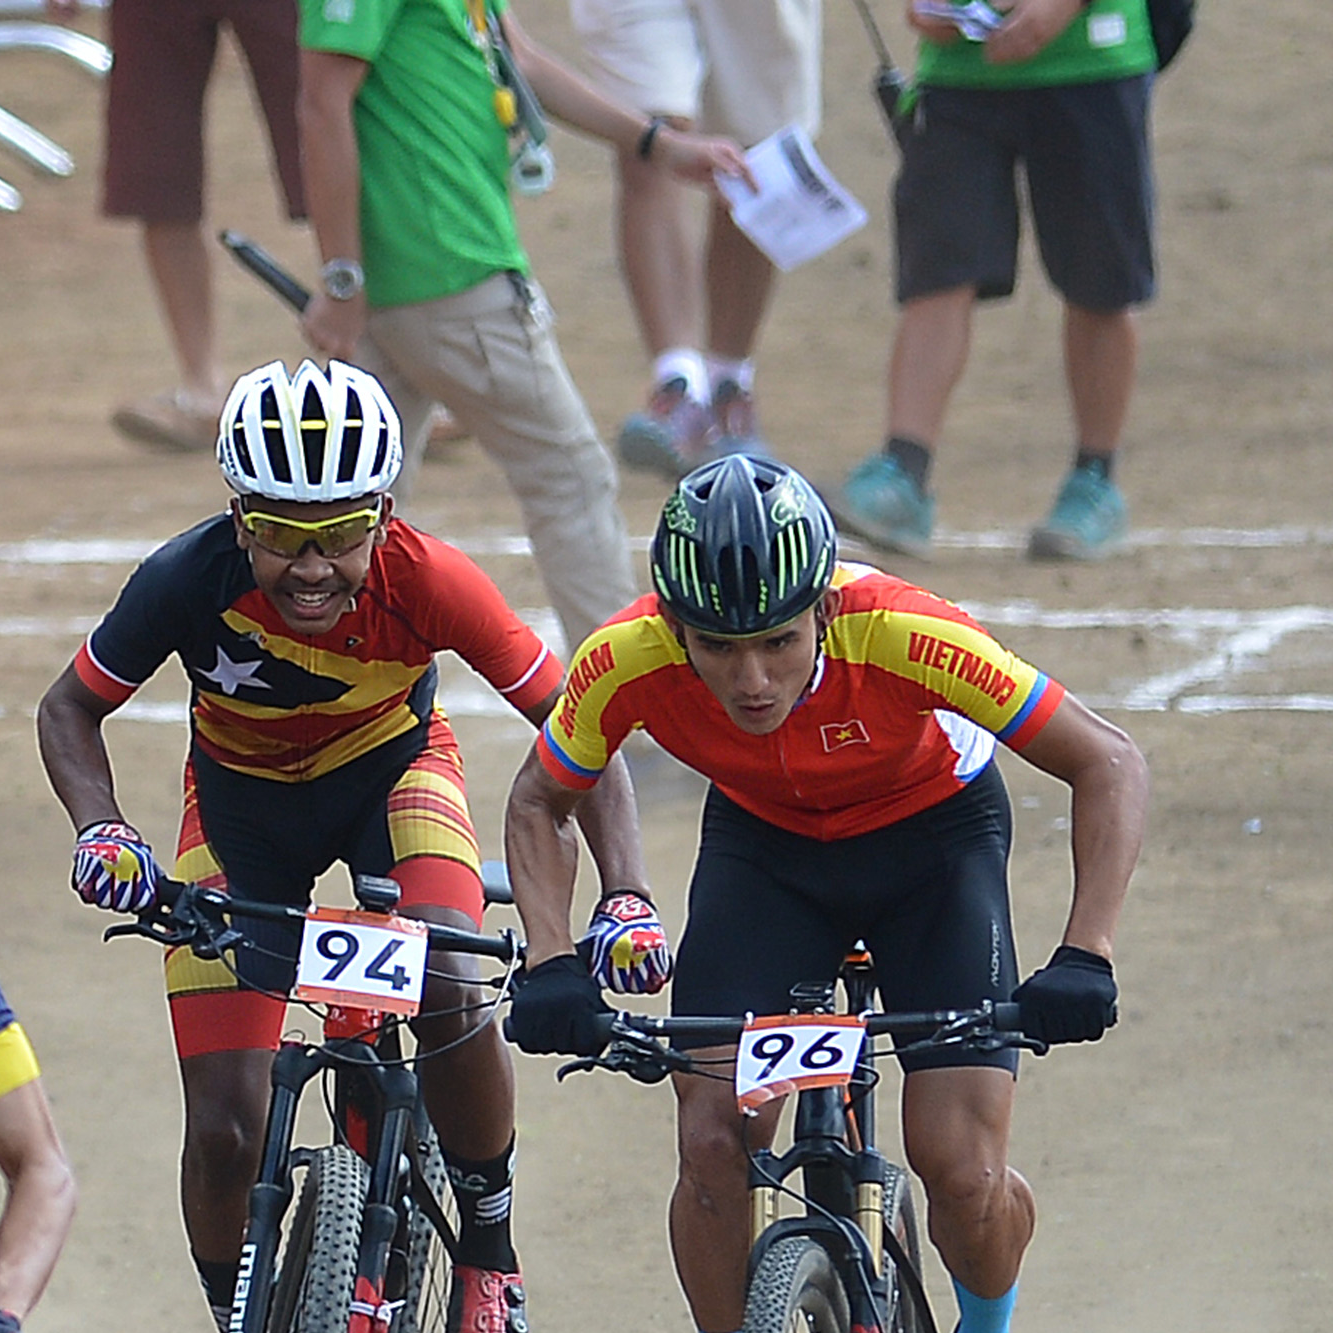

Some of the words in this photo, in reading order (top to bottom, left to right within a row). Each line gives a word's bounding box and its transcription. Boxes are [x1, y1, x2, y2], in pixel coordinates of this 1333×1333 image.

[908, 631, 1018, 708] VIETNAM
[315, 930, 412, 992] 94
[749, 1031, 845, 1083] 96
